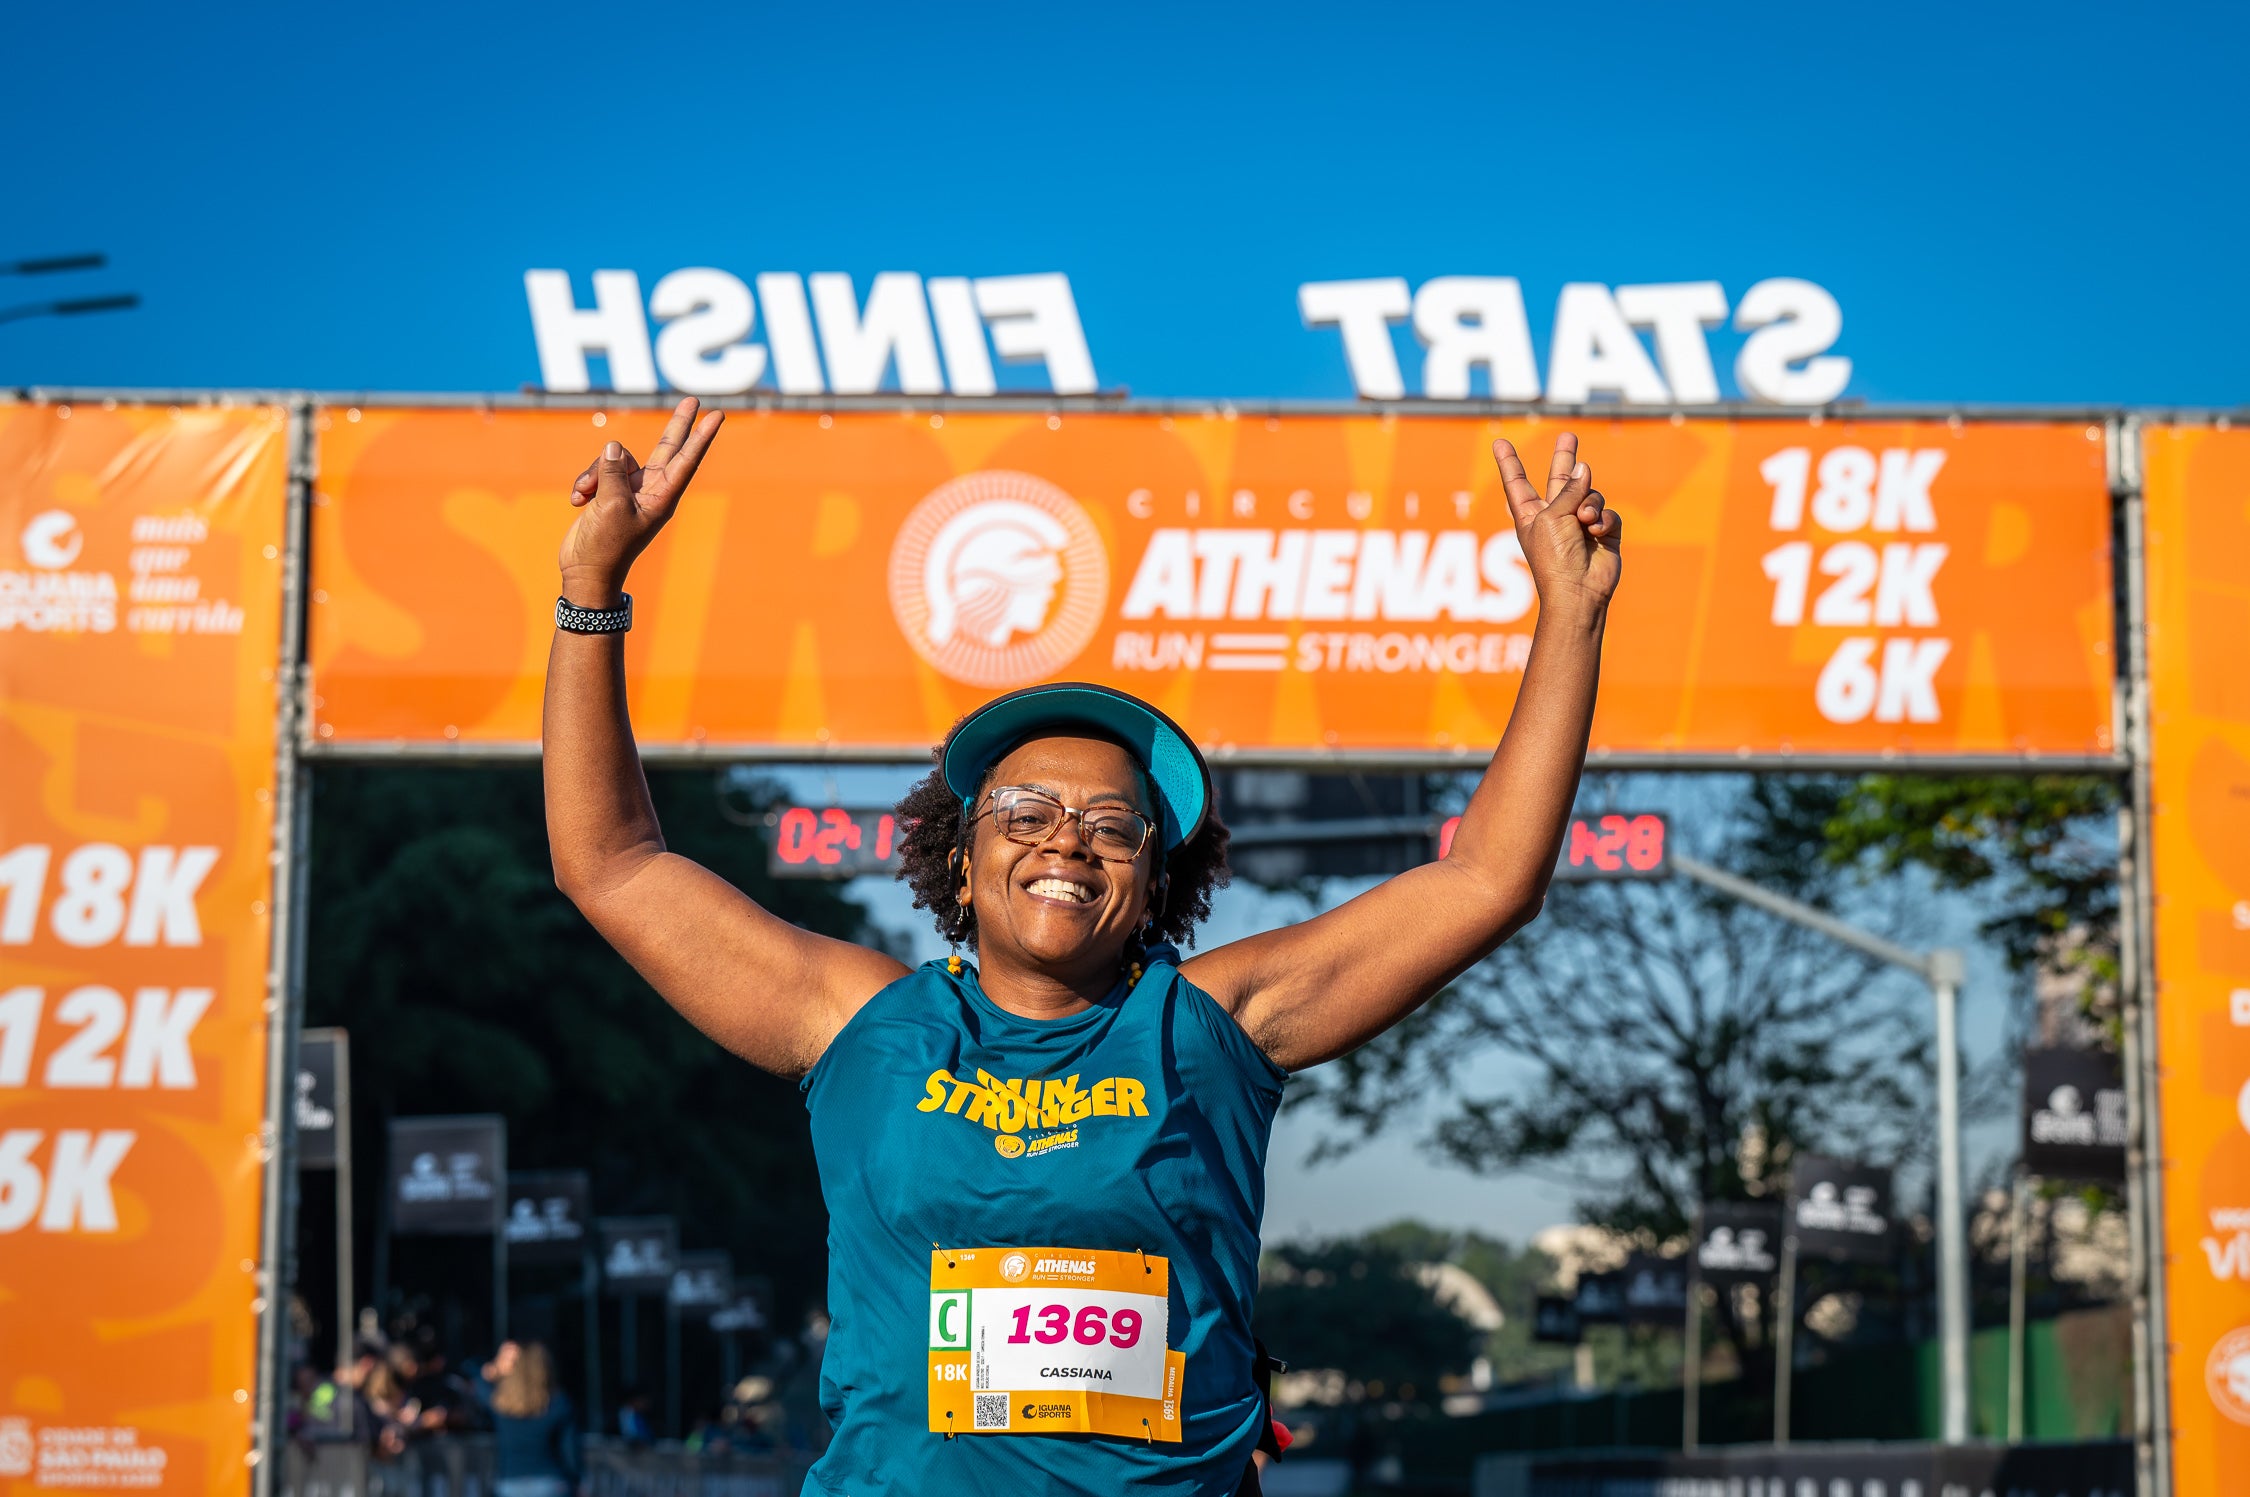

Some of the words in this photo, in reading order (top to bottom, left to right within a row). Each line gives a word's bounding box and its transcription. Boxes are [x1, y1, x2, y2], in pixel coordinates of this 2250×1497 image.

[1126, 488, 1515, 520] CIRCUIT
[1760, 447, 1946, 532] 18K
[0, 571, 117, 601] GUANA
[1121, 528, 1535, 624] ATHENAS
[1762, 542, 1949, 627] 12K
[0, 601, 117, 632] PORTS
[1113, 631, 1203, 672] RUN
[1815, 637, 1951, 724] 6K
[0, 842, 220, 948] 18K
[0, 985, 216, 1089] 12K
[916, 1068, 1150, 1134] STRONGER
[1027, 1129, 1079, 1153] ATHENAS
[1047, 1141, 1080, 1153] STRONGER
[0, 1129, 138, 1234] 6K
[1033, 1259, 1096, 1275] ATHENAS
[938, 1299, 958, 1343] C
[1007, 1304, 1143, 1349] 1369
[934, 1364, 968, 1381] 18K
[1040, 1367, 1113, 1381] CASSIANA
[1166, 1366, 1176, 1398] MEDALHA
[1038, 1411, 1072, 1419] SPORTS
[1164, 1399, 1175, 1421] 1369
